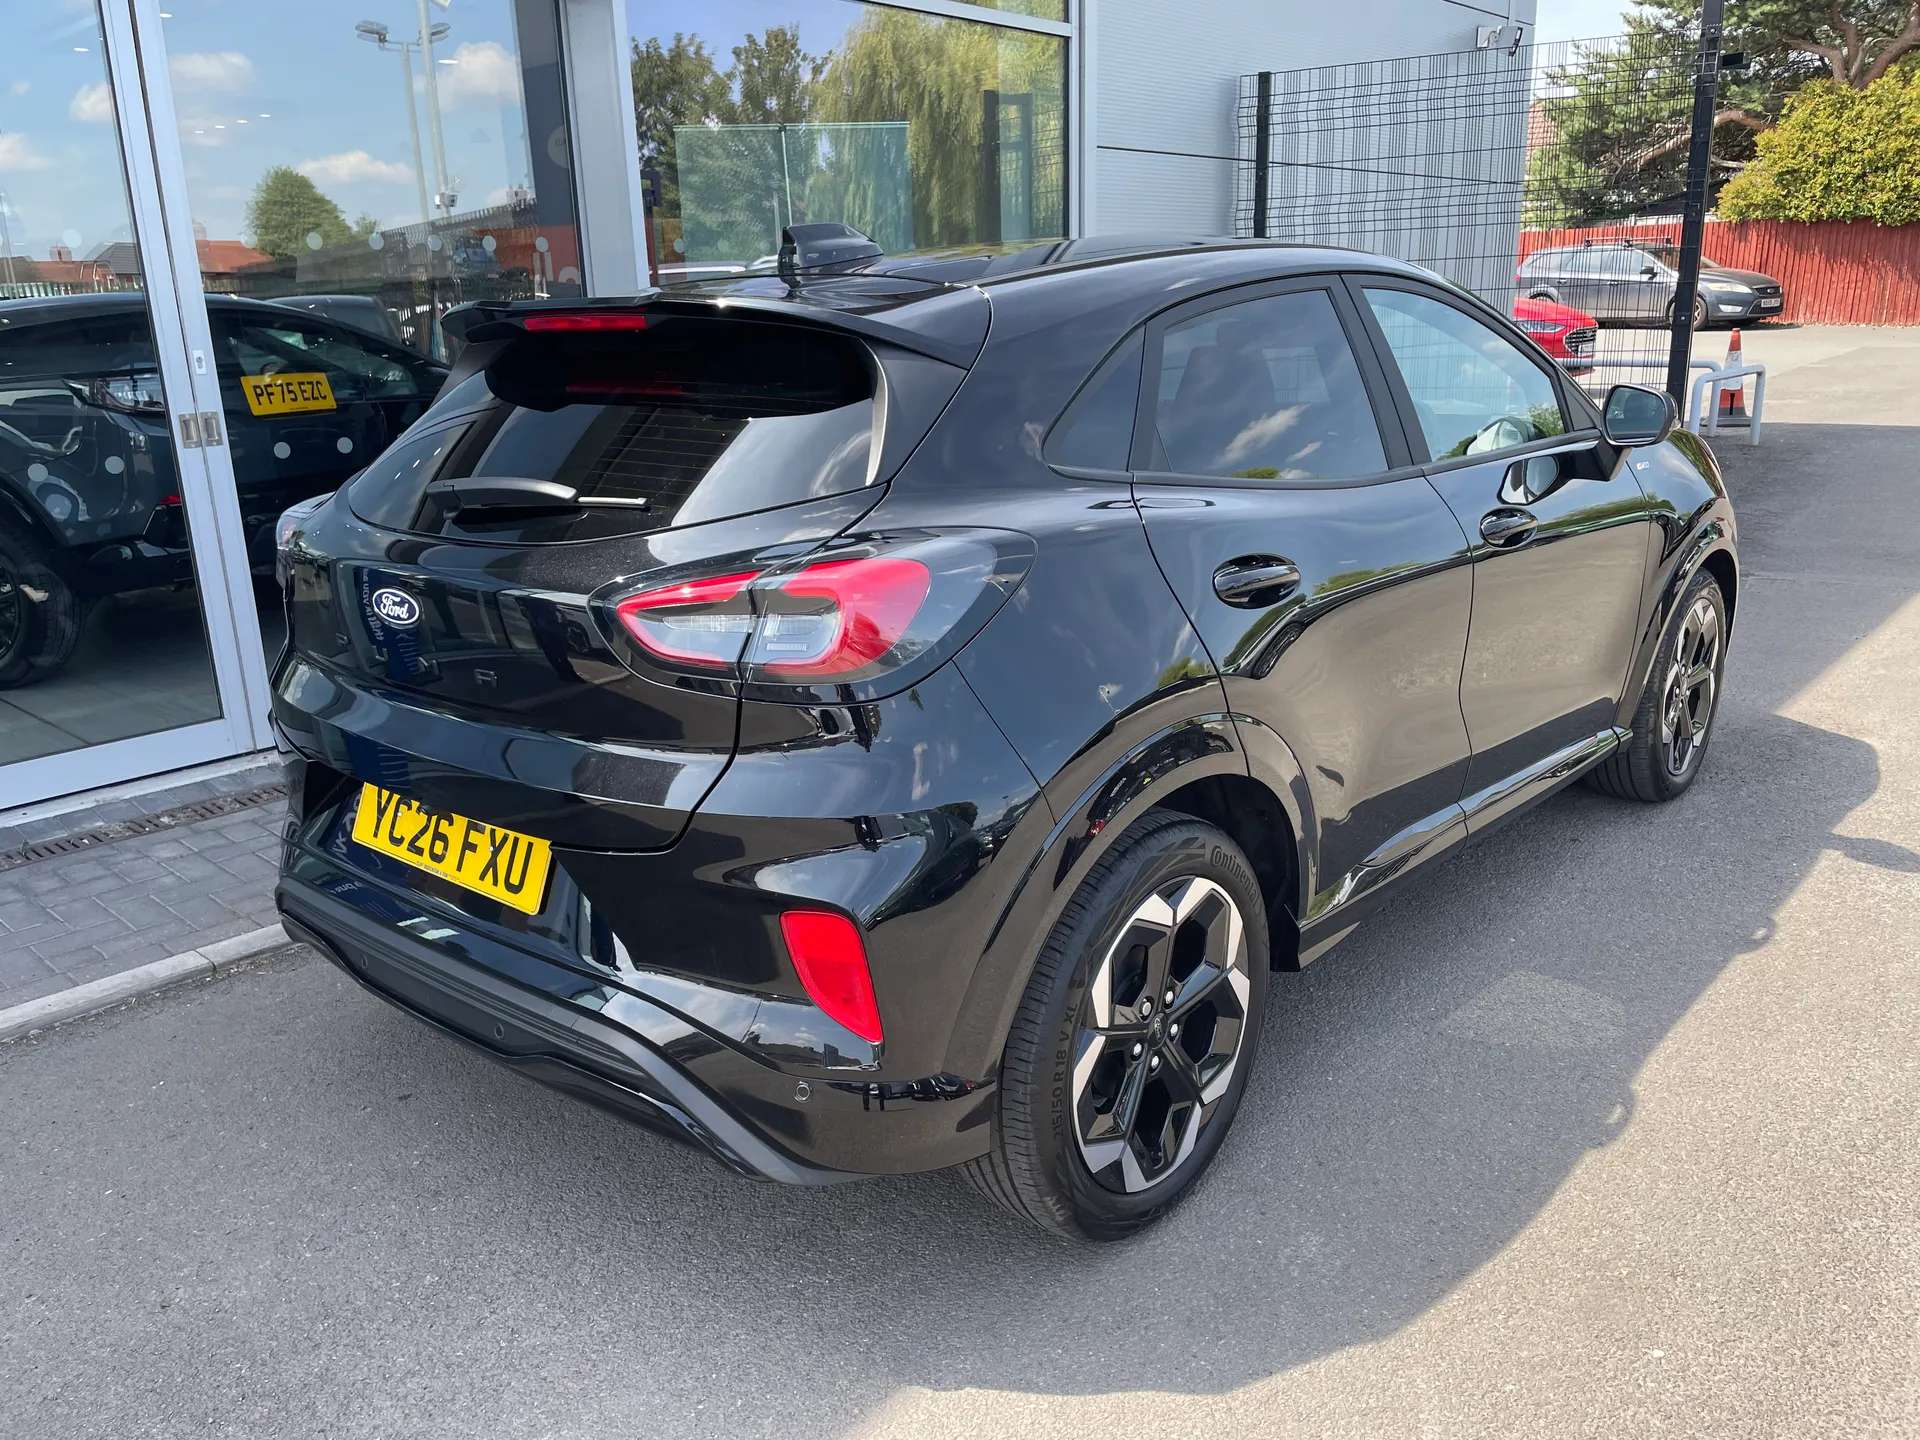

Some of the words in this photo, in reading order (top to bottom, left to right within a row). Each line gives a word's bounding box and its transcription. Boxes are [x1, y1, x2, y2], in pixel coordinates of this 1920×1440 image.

[252, 382, 298, 405] PF75
[298, 380, 327, 402] EZC
[380, 593, 409, 620] Ford
[373, 787, 455, 865] YC26
[455, 820, 534, 895] FXU
[1209, 844, 1260, 909] Continental
